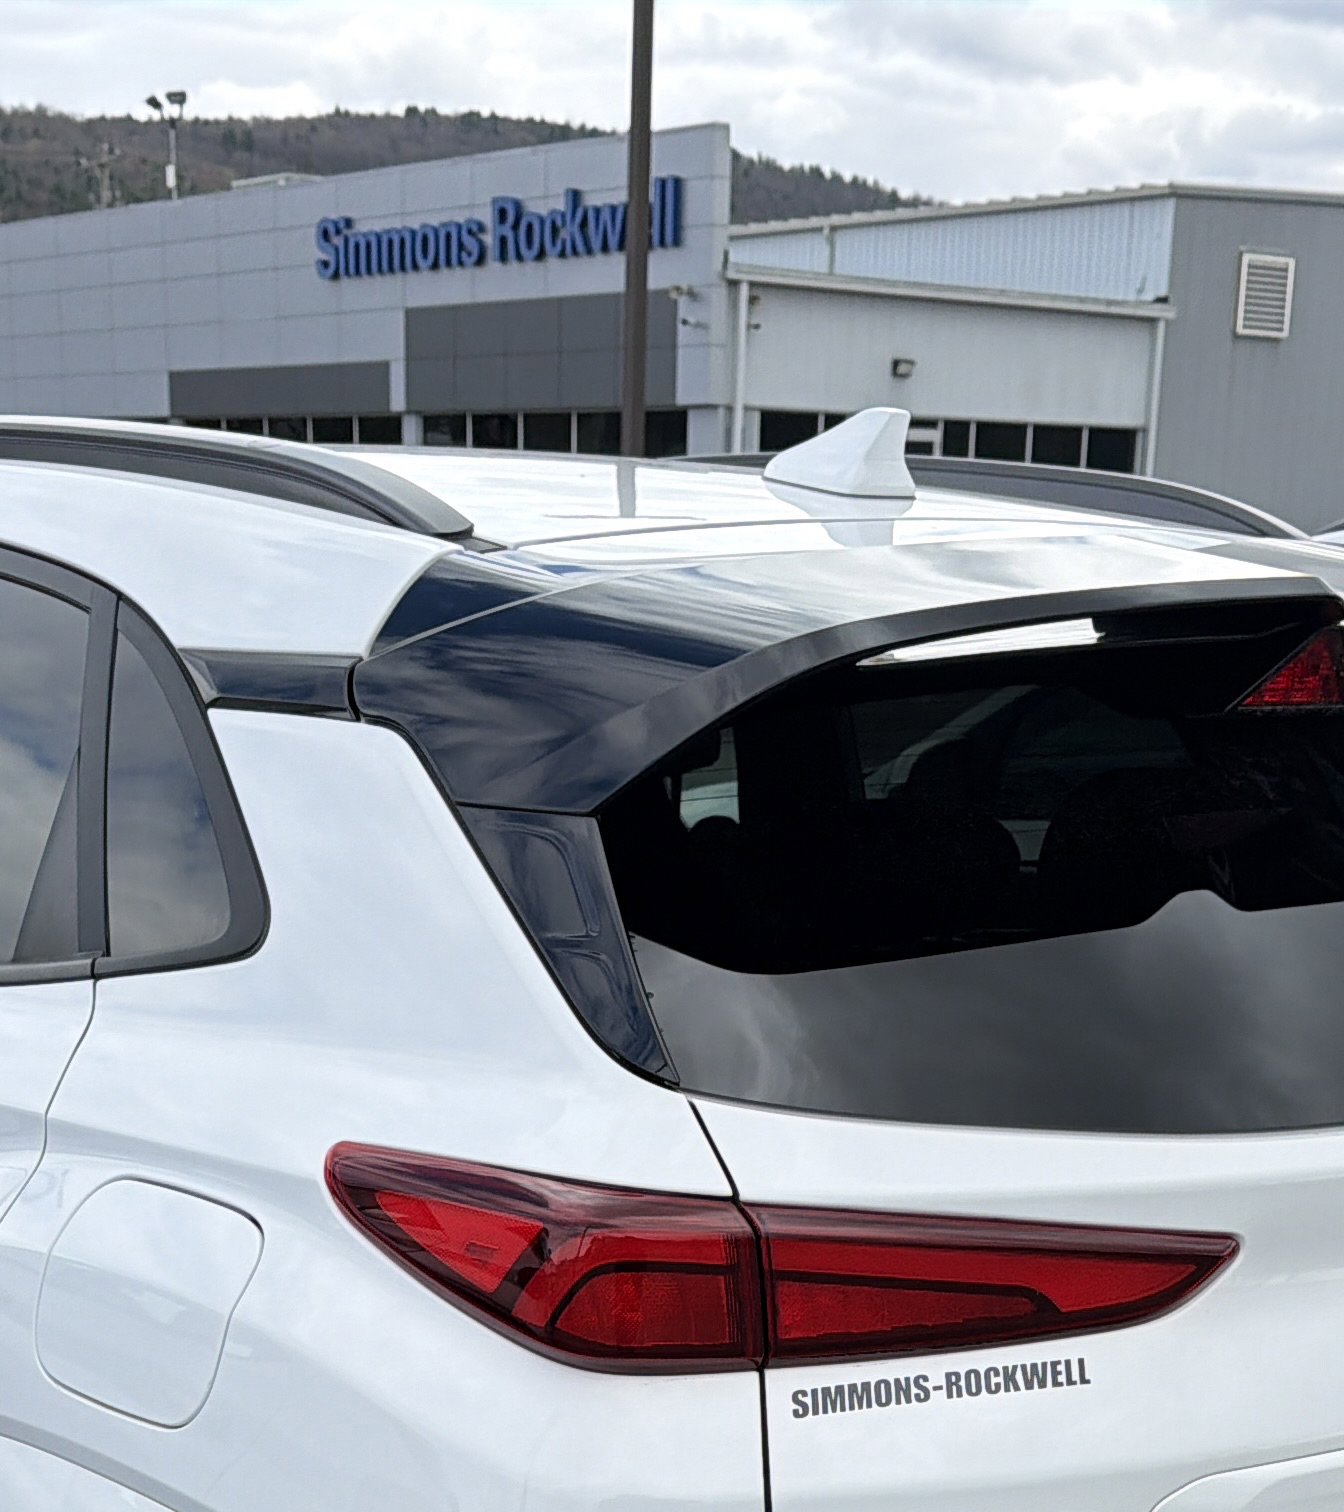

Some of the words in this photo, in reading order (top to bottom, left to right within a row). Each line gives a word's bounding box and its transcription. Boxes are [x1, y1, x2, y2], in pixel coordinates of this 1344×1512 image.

[316, 216, 487, 280] Simmons
[492, 175, 682, 263] Rockwll
[791, 1357, 1092, 1419] SIMMONS-ROCKWELL
